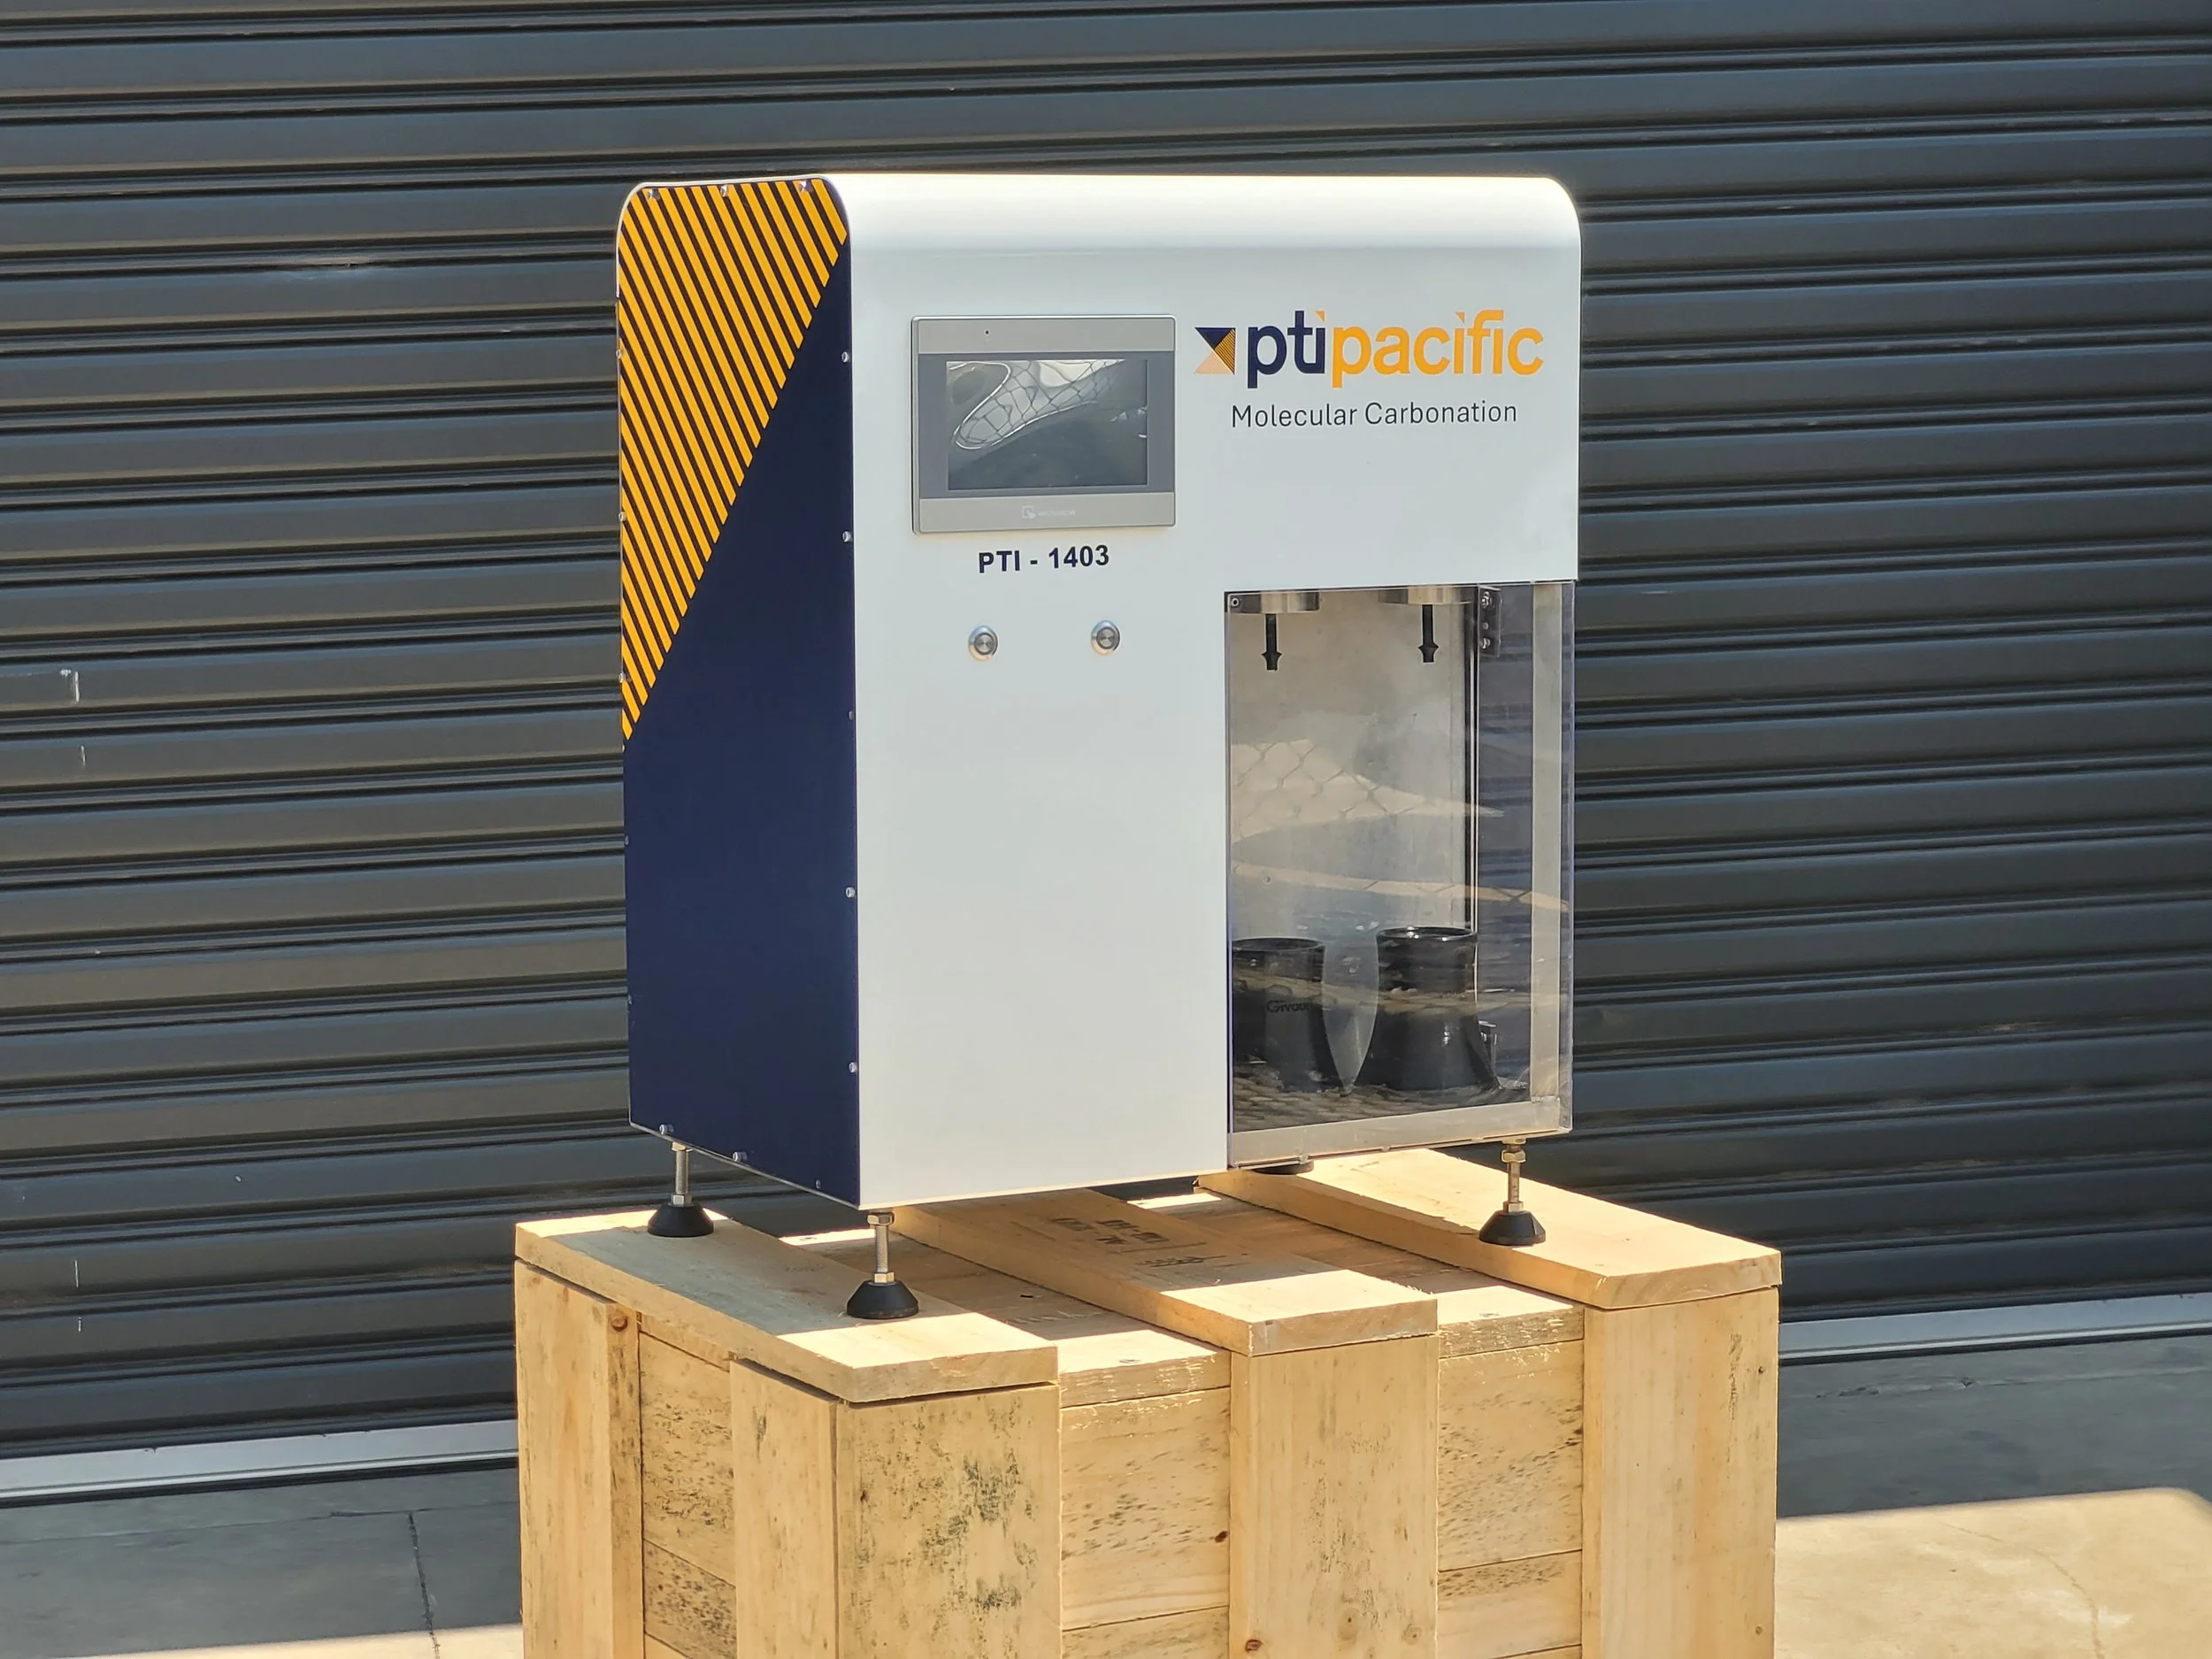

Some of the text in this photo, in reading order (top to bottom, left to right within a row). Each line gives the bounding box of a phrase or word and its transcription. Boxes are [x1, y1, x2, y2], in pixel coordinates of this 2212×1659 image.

[1232, 400, 1517, 428] Molecular Carbonation
[979, 550, 1021, 573] PTI
[1048, 545, 1110, 569] 1403
